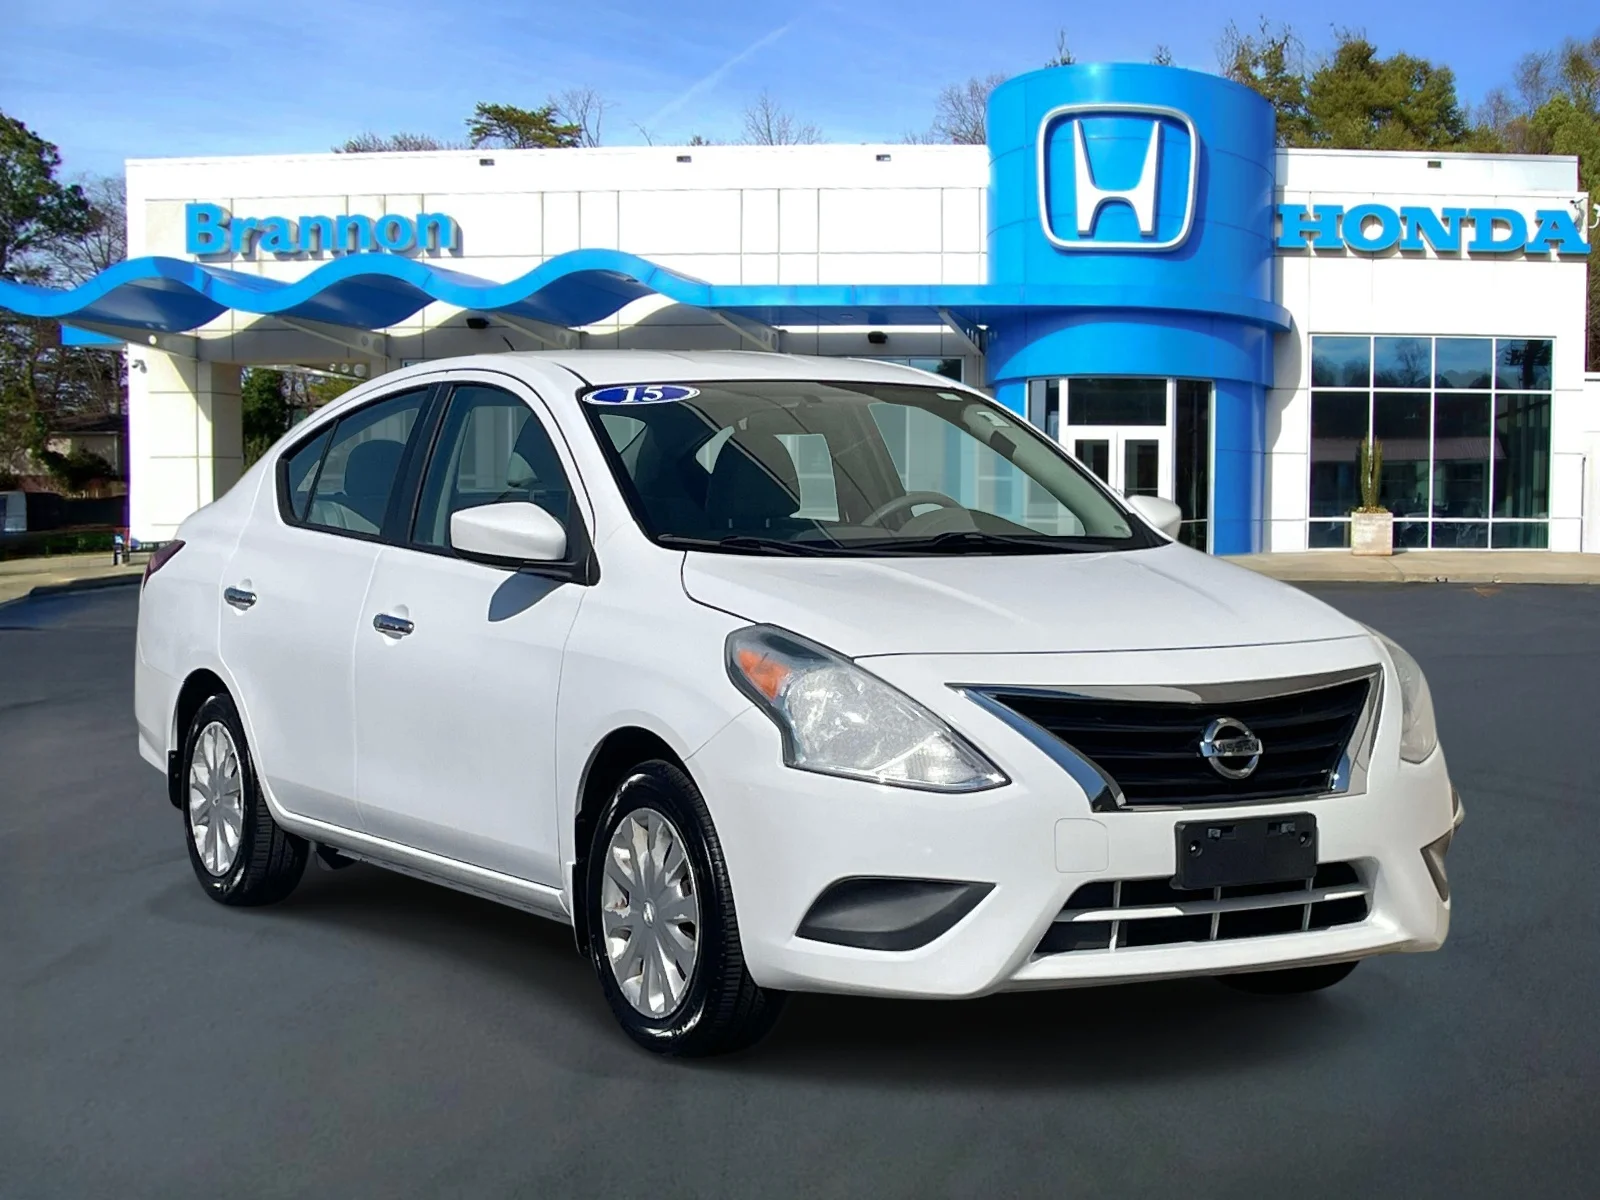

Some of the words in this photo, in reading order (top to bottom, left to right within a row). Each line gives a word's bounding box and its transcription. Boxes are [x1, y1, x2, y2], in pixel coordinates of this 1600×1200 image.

[185, 202, 456, 255] Brannon
[1277, 203, 1592, 255] HONDA
[620, 386, 664, 403] 15
